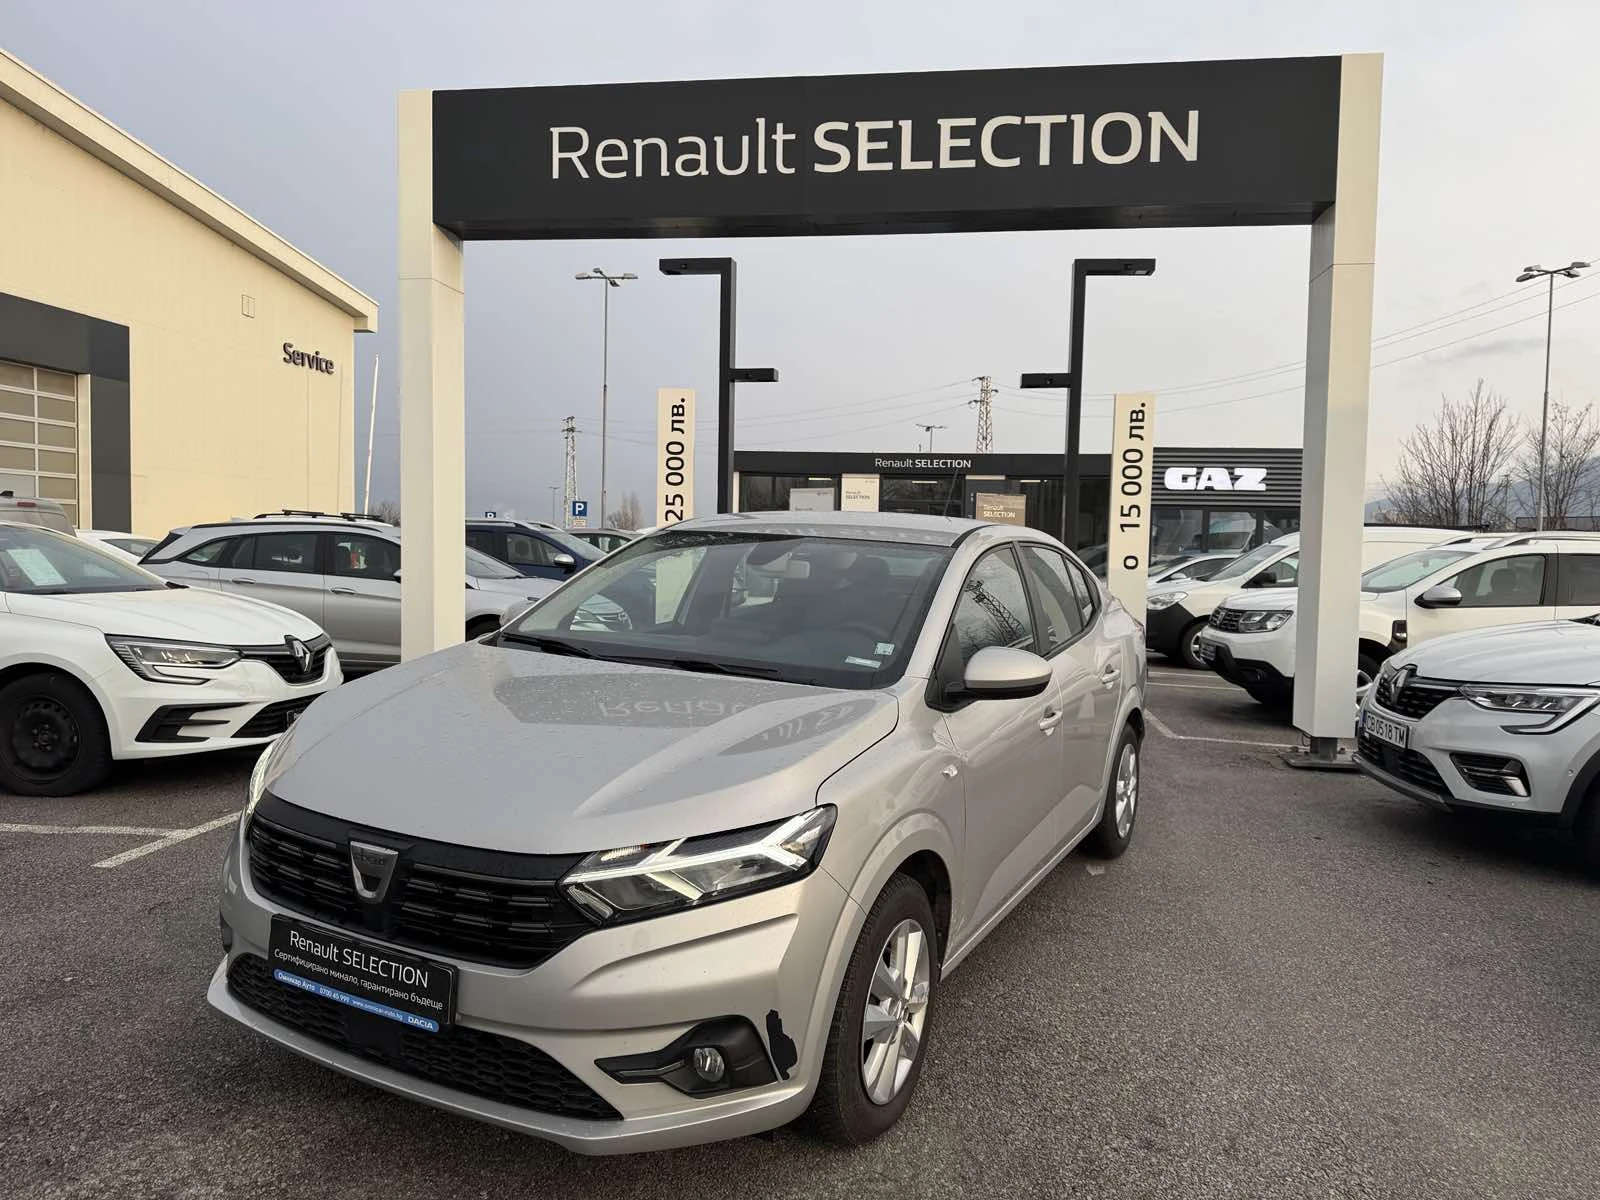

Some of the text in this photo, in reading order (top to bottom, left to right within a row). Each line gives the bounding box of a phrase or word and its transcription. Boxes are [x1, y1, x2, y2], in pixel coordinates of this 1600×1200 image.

[550, 111, 1198, 178] Renault SELECTION
[282, 342, 335, 375] Service
[1128, 402, 1146, 441] лв.
[664, 397, 686, 522] 25 000 лв.
[874, 458, 972, 468] Renault SELECTION
[1121, 448, 1144, 496] 000
[1164, 467, 1267, 491] GAZ
[575, 502, 585, 515] P
[1119, 504, 1141, 533] 15
[290, 931, 428, 989] Renault SELECTION
[274, 948, 443, 1011] Сертифицирано минало, гарантирано бъдеще
[408, 1016, 434, 1030] DACIA
